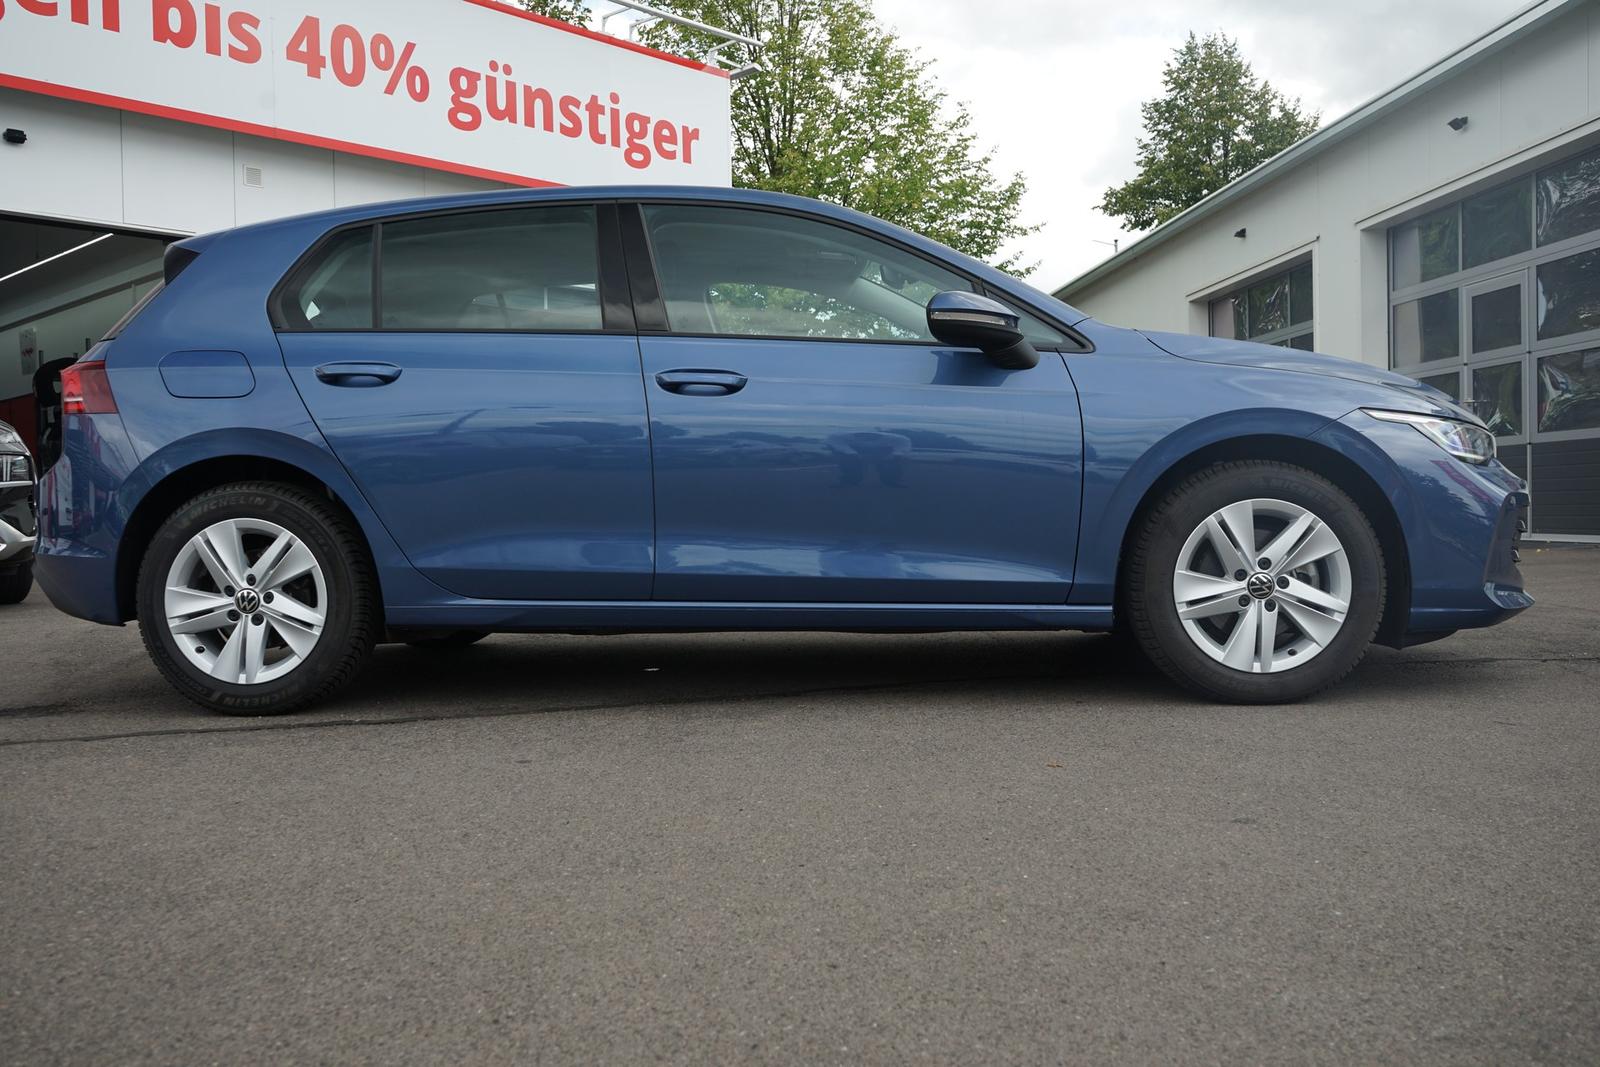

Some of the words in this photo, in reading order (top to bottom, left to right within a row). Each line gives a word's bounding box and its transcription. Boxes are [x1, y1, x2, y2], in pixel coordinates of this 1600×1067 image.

[152, 0, 260, 65] bis
[287, 17, 430, 103] 40%
[447, 60, 700, 169] günstiger
